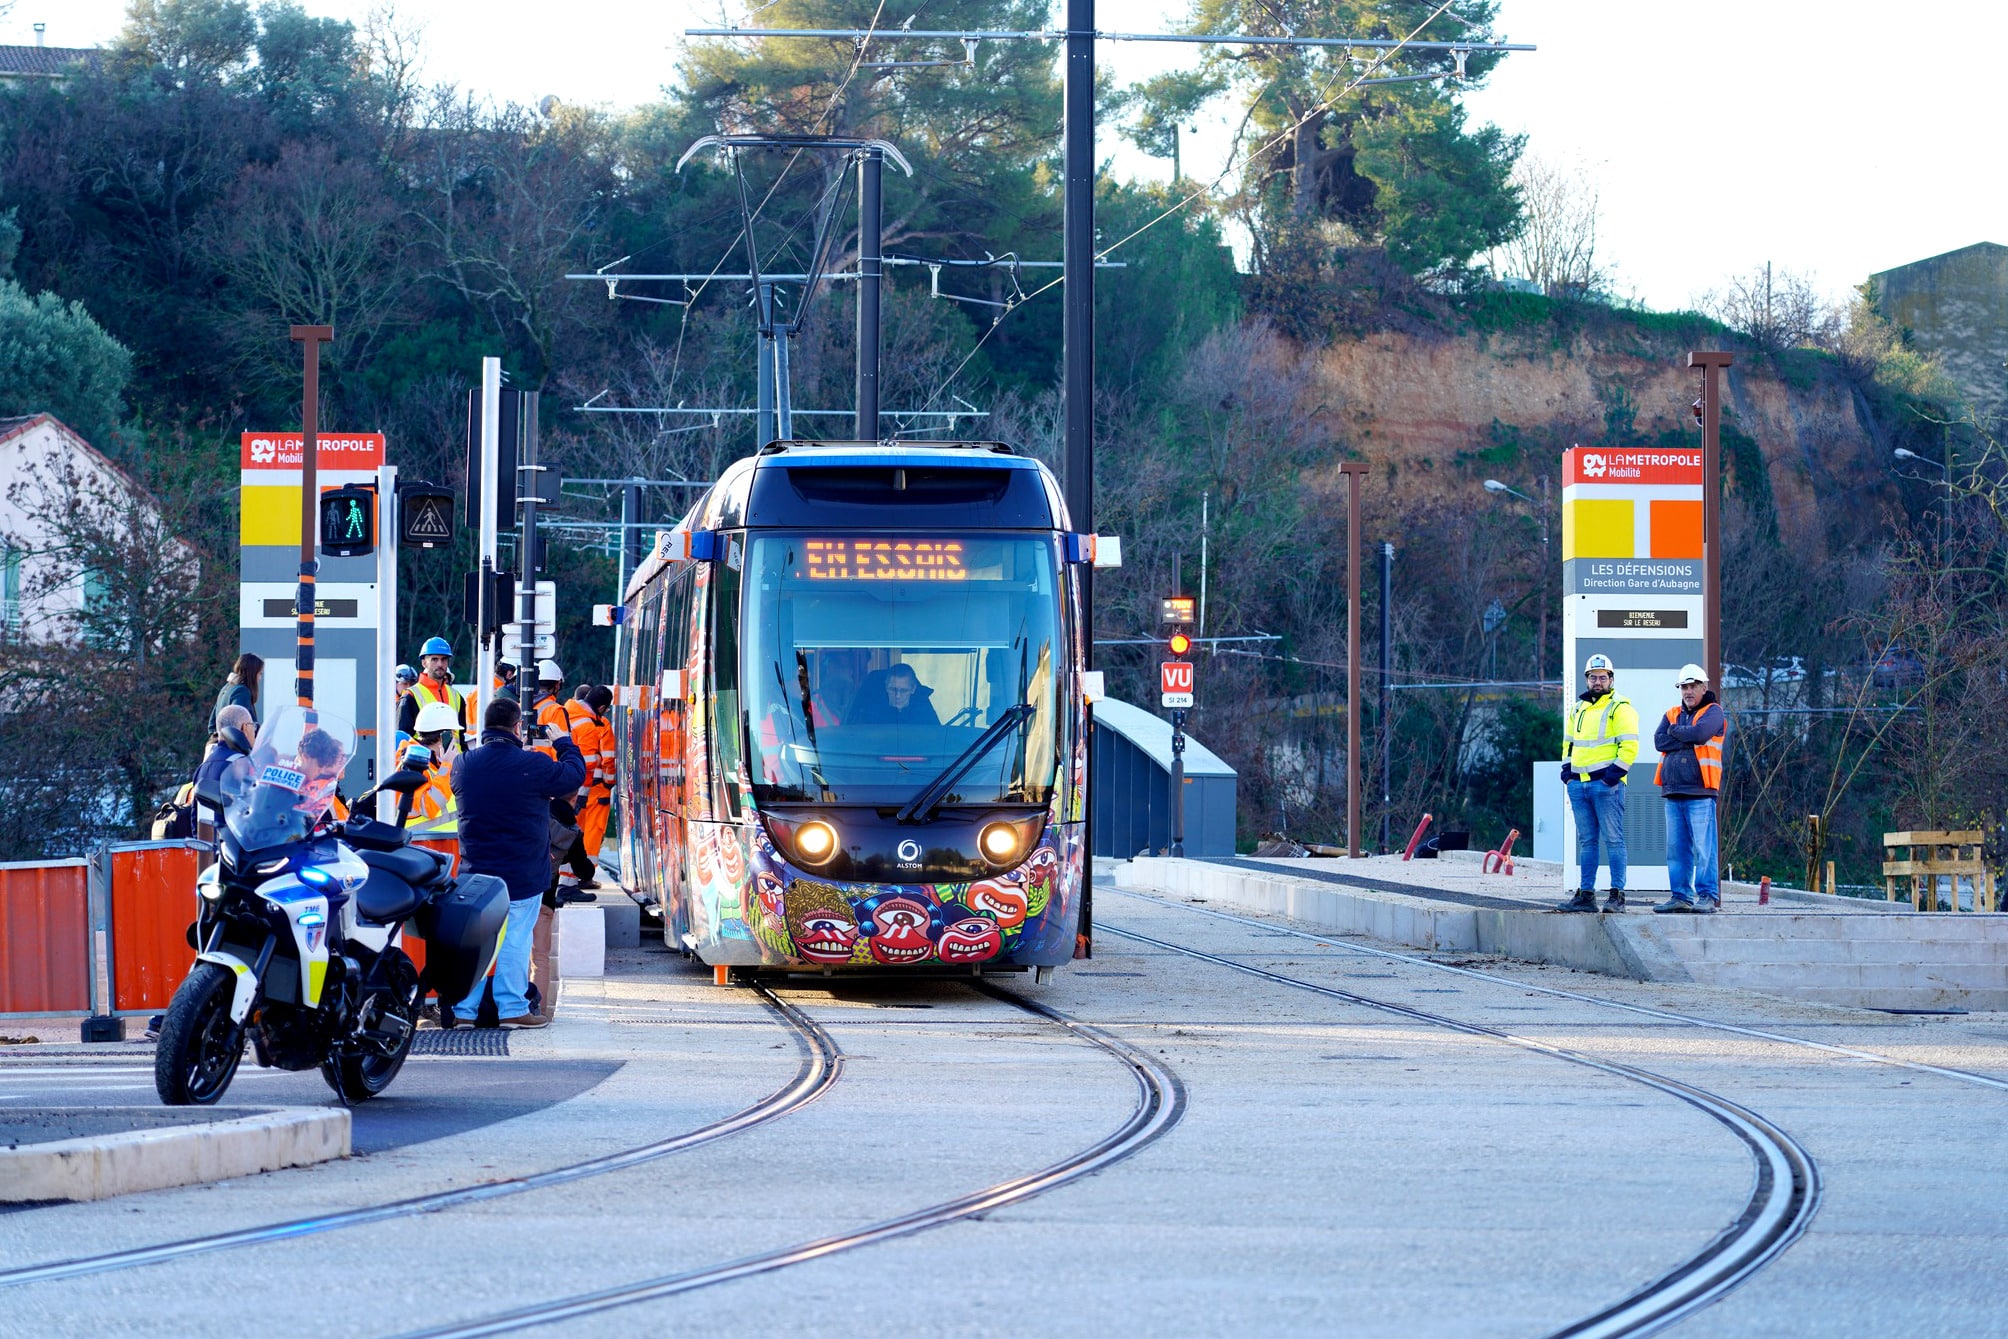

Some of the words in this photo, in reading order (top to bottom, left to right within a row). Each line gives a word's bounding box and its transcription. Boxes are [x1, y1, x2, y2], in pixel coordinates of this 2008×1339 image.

[278, 452, 303, 463] Mobili
[1609, 467, 1640, 478] Mobilité
[807, 542, 848, 578] EN
[855, 543, 966, 579] ESSAIS
[1591, 564, 1614, 575] LES
[1616, 562, 1692, 576] DÉFENSIONS
[1583, 578, 1625, 588] Direction
[1627, 579, 1649, 588] Gare
[1651, 579, 1700, 590] d'Aubagne
[1163, 668, 1191, 687] VU
[264, 767, 303, 784] POLICE
